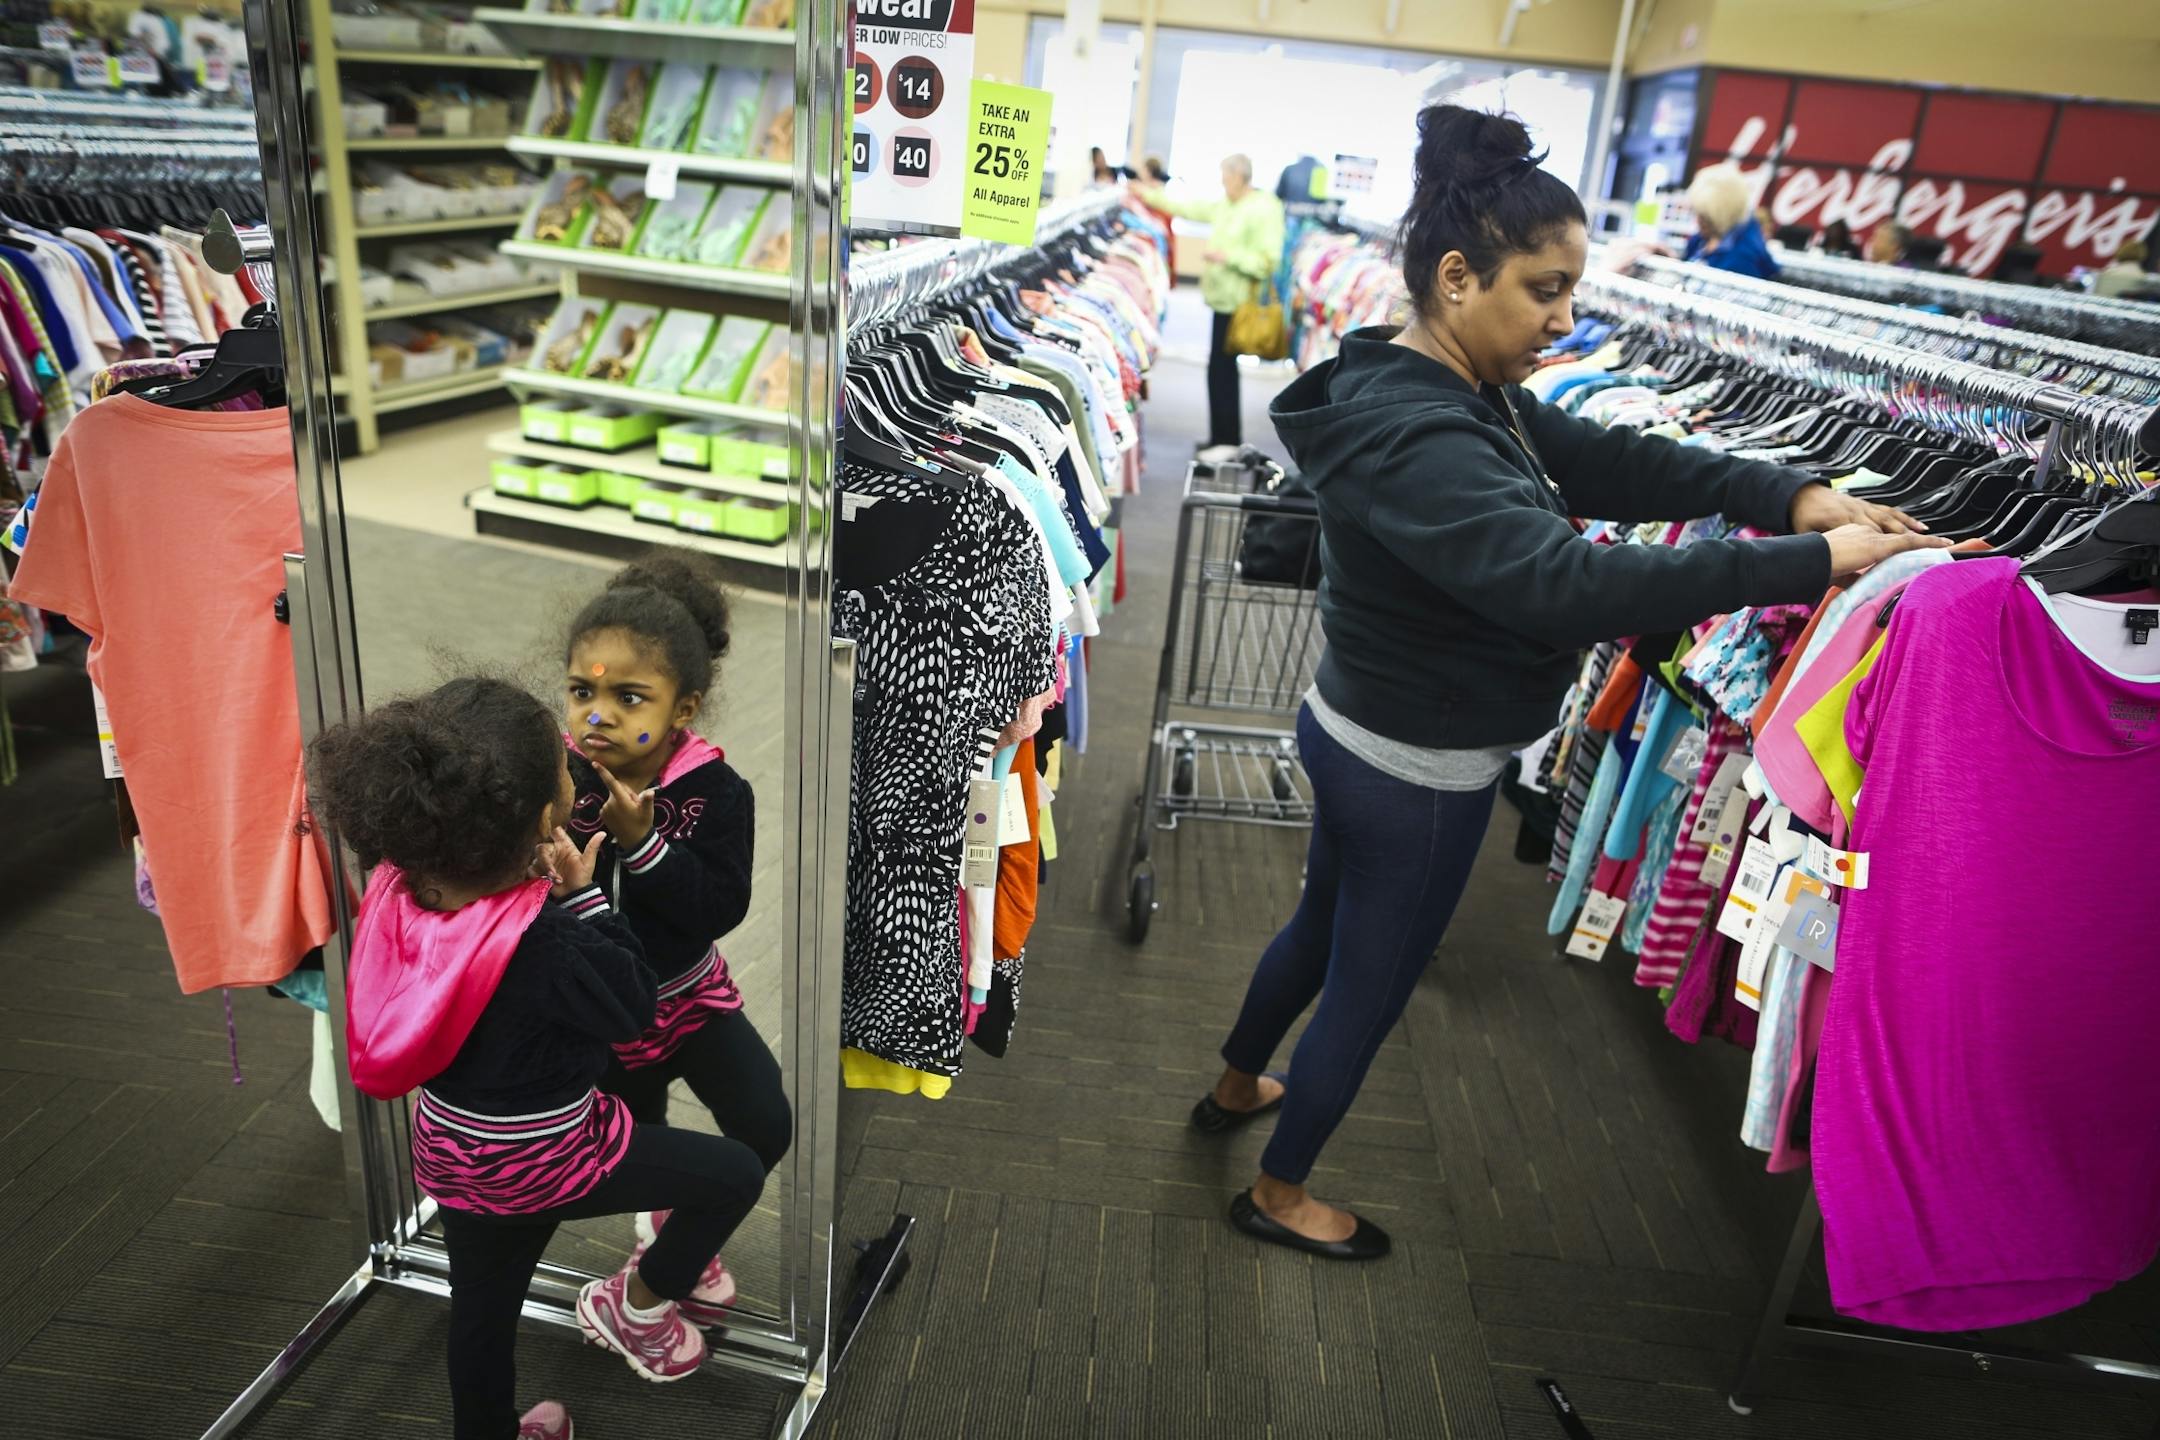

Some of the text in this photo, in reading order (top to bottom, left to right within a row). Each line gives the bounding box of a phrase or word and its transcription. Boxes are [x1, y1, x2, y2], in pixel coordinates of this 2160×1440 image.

[872, 29, 900, 45] LOW
[903, 31, 948, 48] PRICES!
[898, 73, 931, 100] $14
[982, 103, 1030, 123] TAKE AN
[979, 122, 1016, 140] EXTRA
[895, 143, 927, 170] $40
[1011, 170, 1029, 182] OFF
[973, 187, 1030, 208] All Apparel
